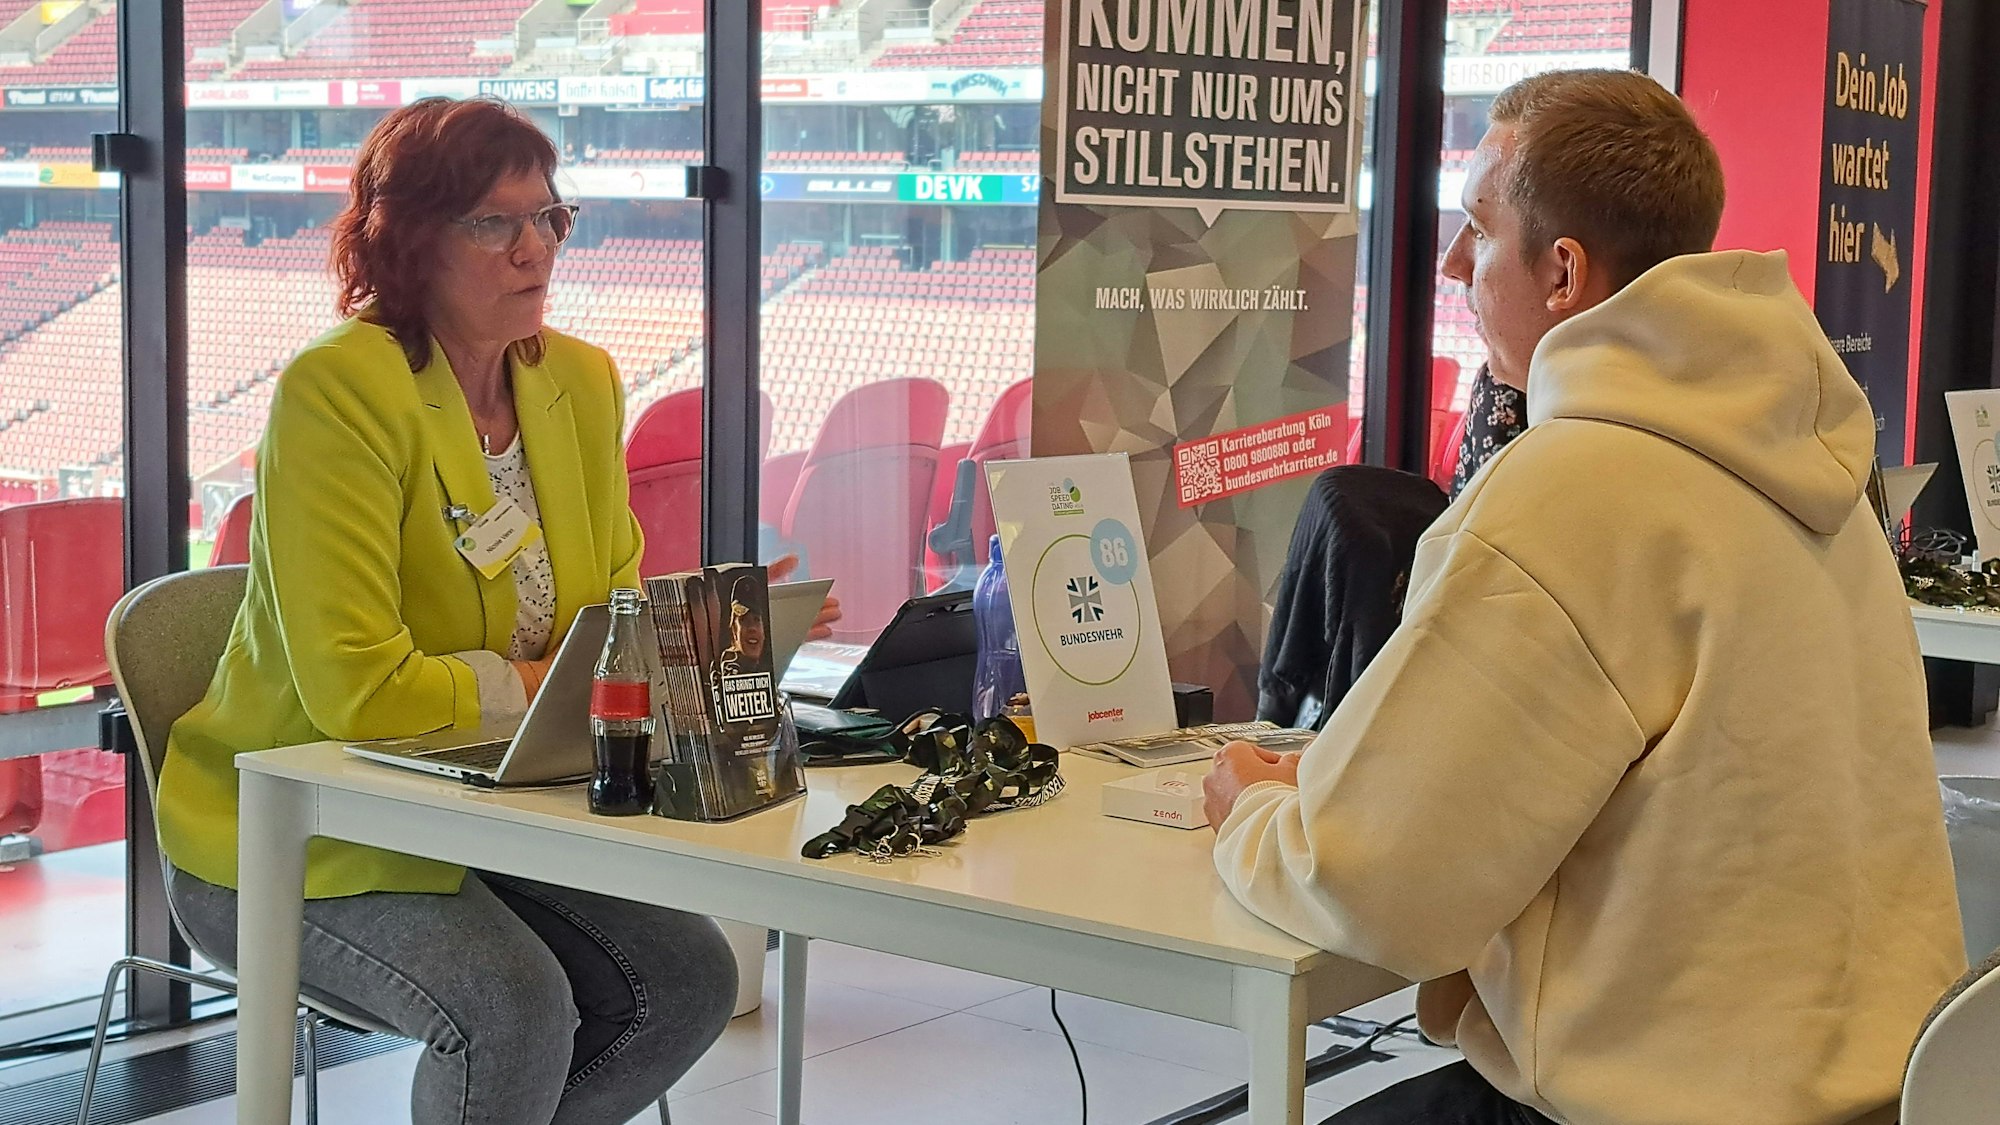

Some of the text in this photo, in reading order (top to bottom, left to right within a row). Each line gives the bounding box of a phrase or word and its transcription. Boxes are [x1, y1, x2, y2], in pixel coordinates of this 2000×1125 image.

[1076, 63, 1344, 126] NICHT NUR UMS
[1835, 52, 1909, 120] Dein Job
[1074, 126, 1340, 194] STILLSTEHEN.
[1832, 137, 1890, 190] wartet
[915, 175, 984, 201] DEVK
[1827, 203, 1865, 263] hier
[1095, 285, 1309, 313] MACH, WAS WIRKLICH ZÄHLT.
[1845, 332, 1872, 353] Bereiche
[1221, 413, 1332, 454] Karriereberatung Köln
[1223, 437, 1317, 473] 0800 9800880 oder
[1225, 449, 1338, 491] bundeswehrkarriere.de
[1049, 486, 1061, 495] JOB
[1050, 494, 1070, 503] SPEED
[1052, 502, 1074, 510] DATING
[1100, 537, 1129, 568] 86
[1060, 628, 1124, 646] BUNDESWEHR
[755, 676, 769, 689] DICH
[726, 691, 772, 718] WEITER.
[1087, 708, 1124, 723] jobcenter
